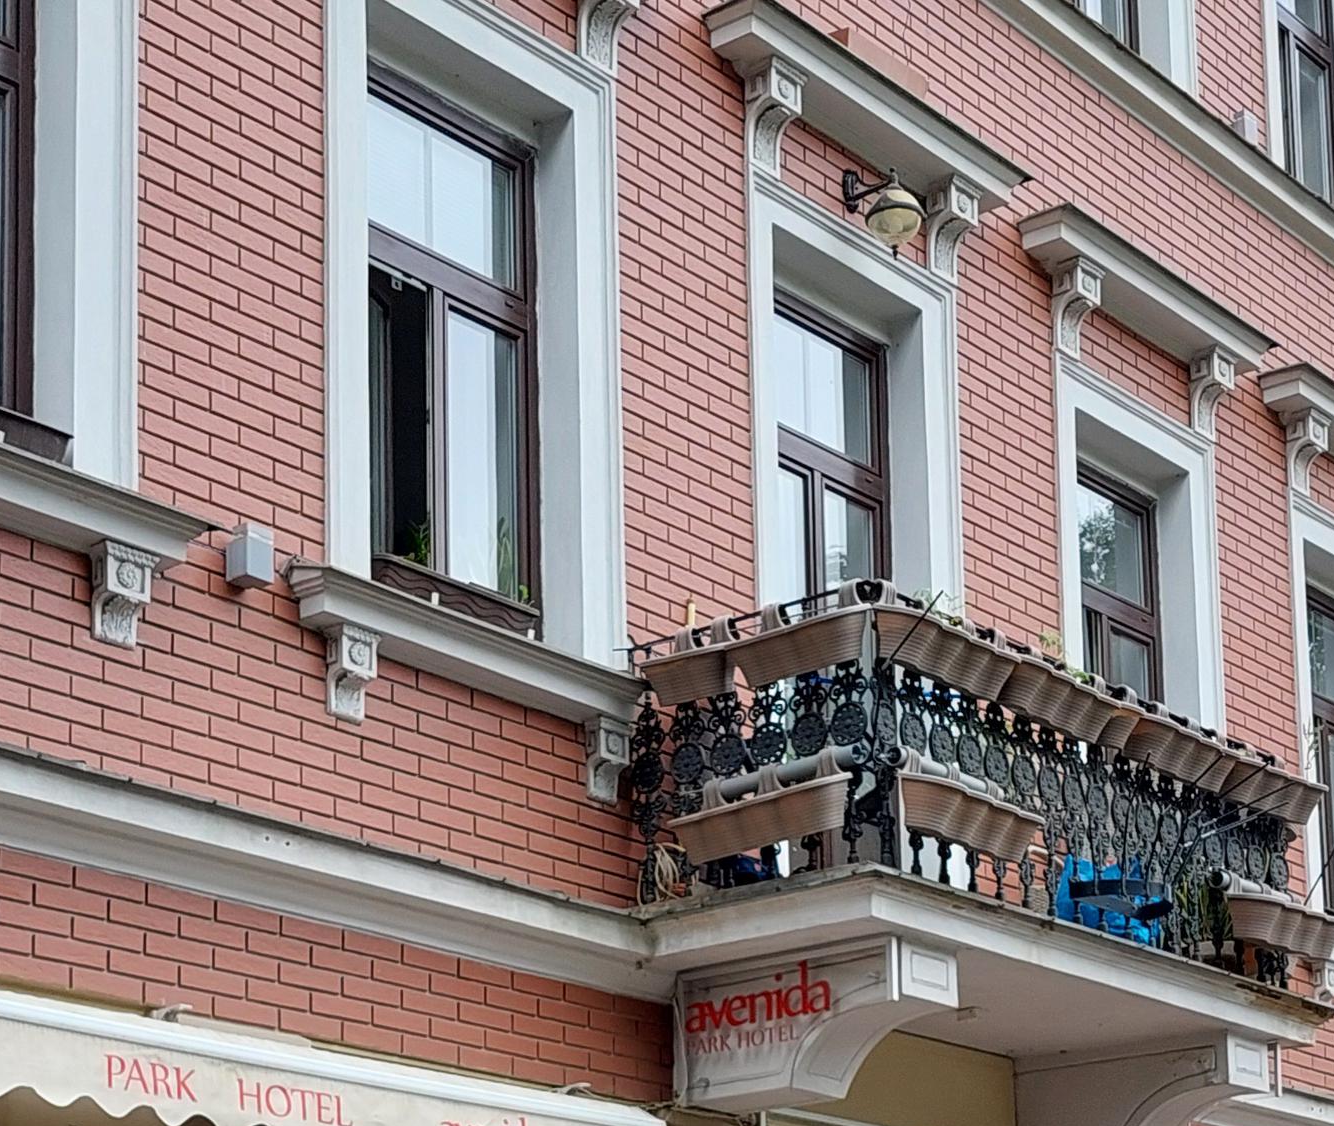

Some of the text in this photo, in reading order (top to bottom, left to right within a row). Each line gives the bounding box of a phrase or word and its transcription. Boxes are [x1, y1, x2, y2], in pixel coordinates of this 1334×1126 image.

[685, 960, 832, 1035] avenida
[686, 1024, 799, 1056] PARK HOTEL
[104, 1053, 198, 1102] PARK
